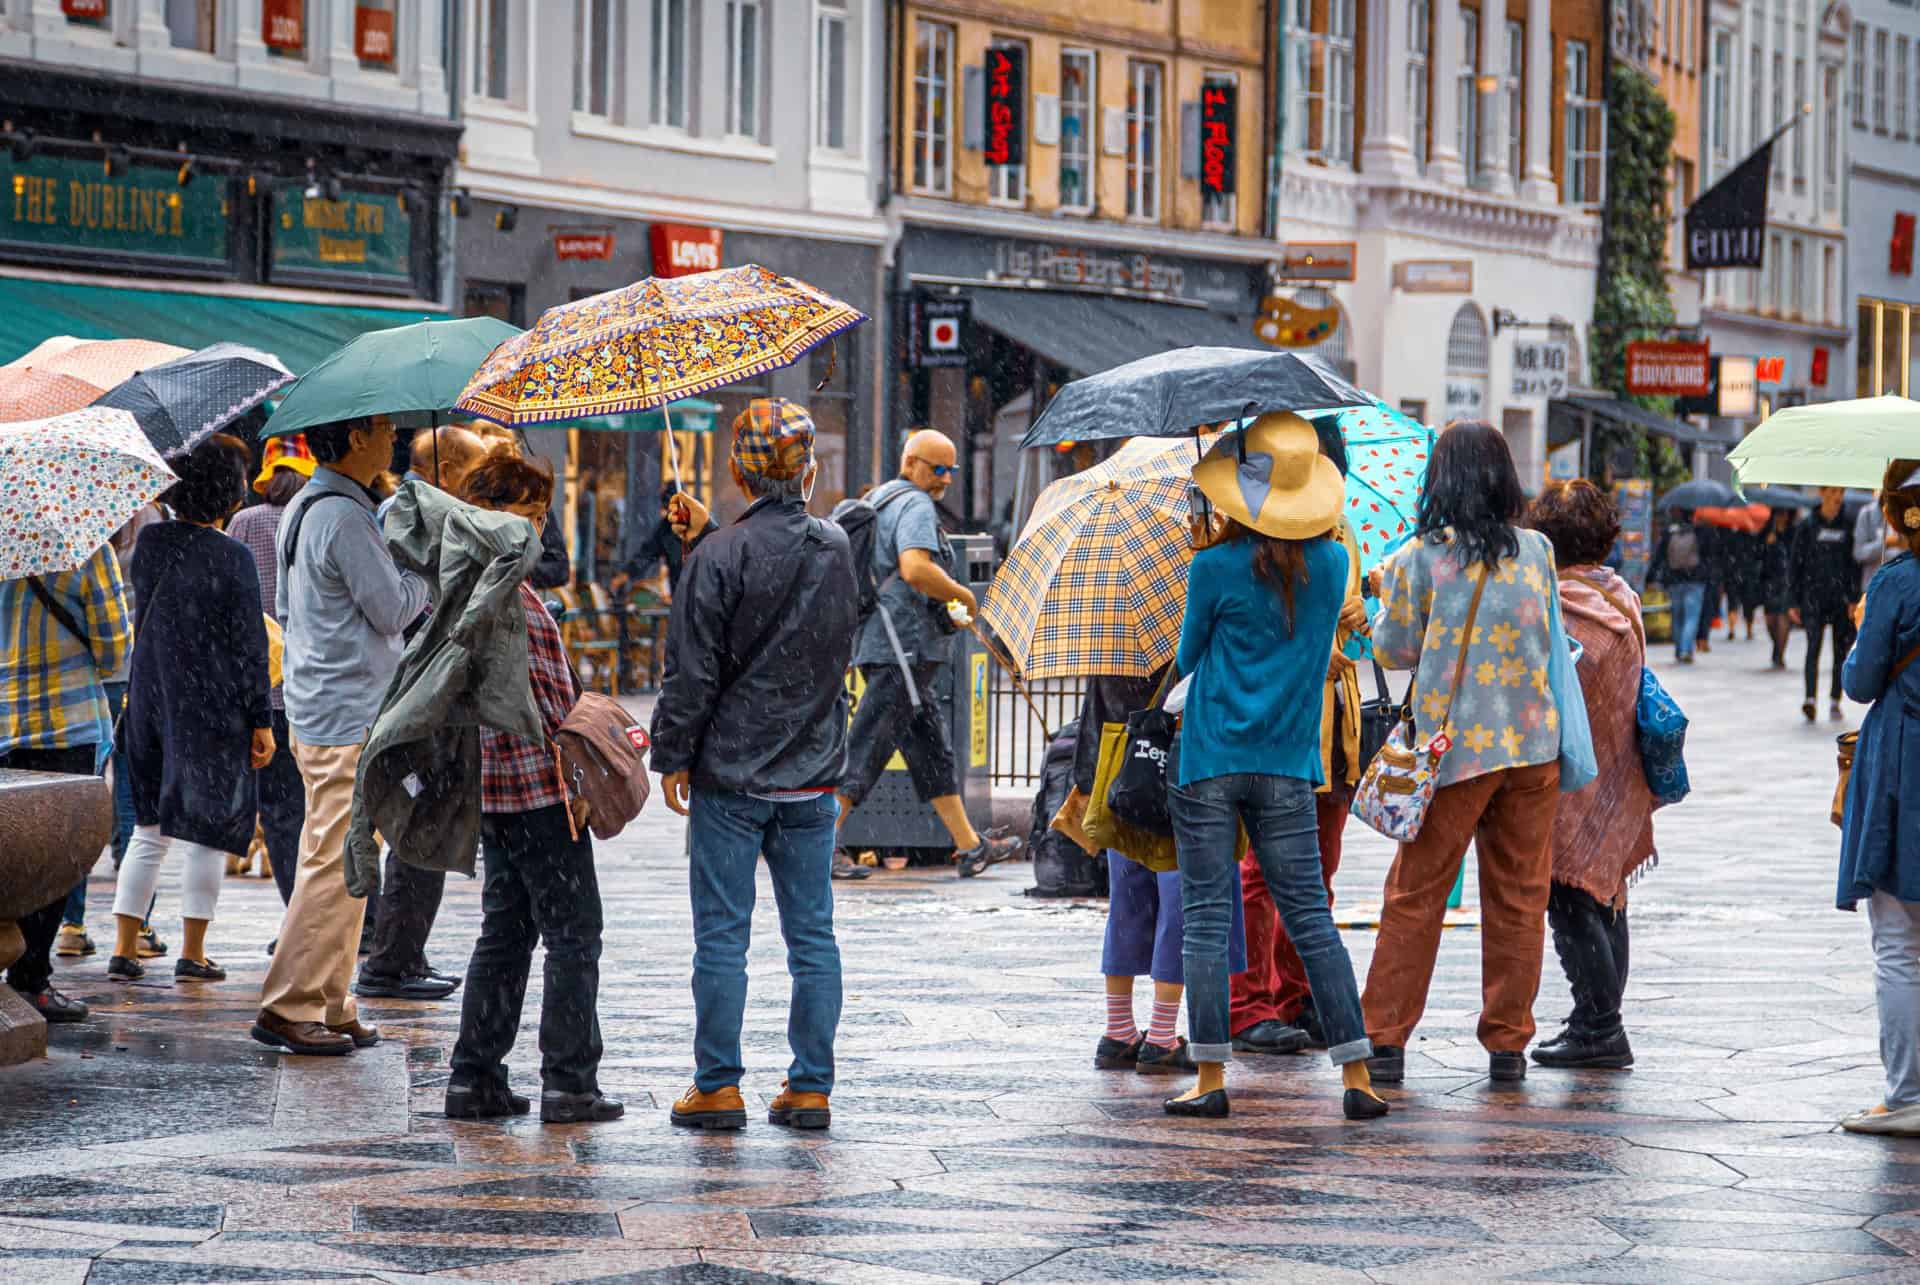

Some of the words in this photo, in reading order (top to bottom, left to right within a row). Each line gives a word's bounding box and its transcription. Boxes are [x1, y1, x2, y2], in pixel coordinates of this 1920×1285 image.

[1202, 121, 1230, 193] Floor
[13, 175, 57, 224] THE
[69, 180, 183, 236] DUBLINER
